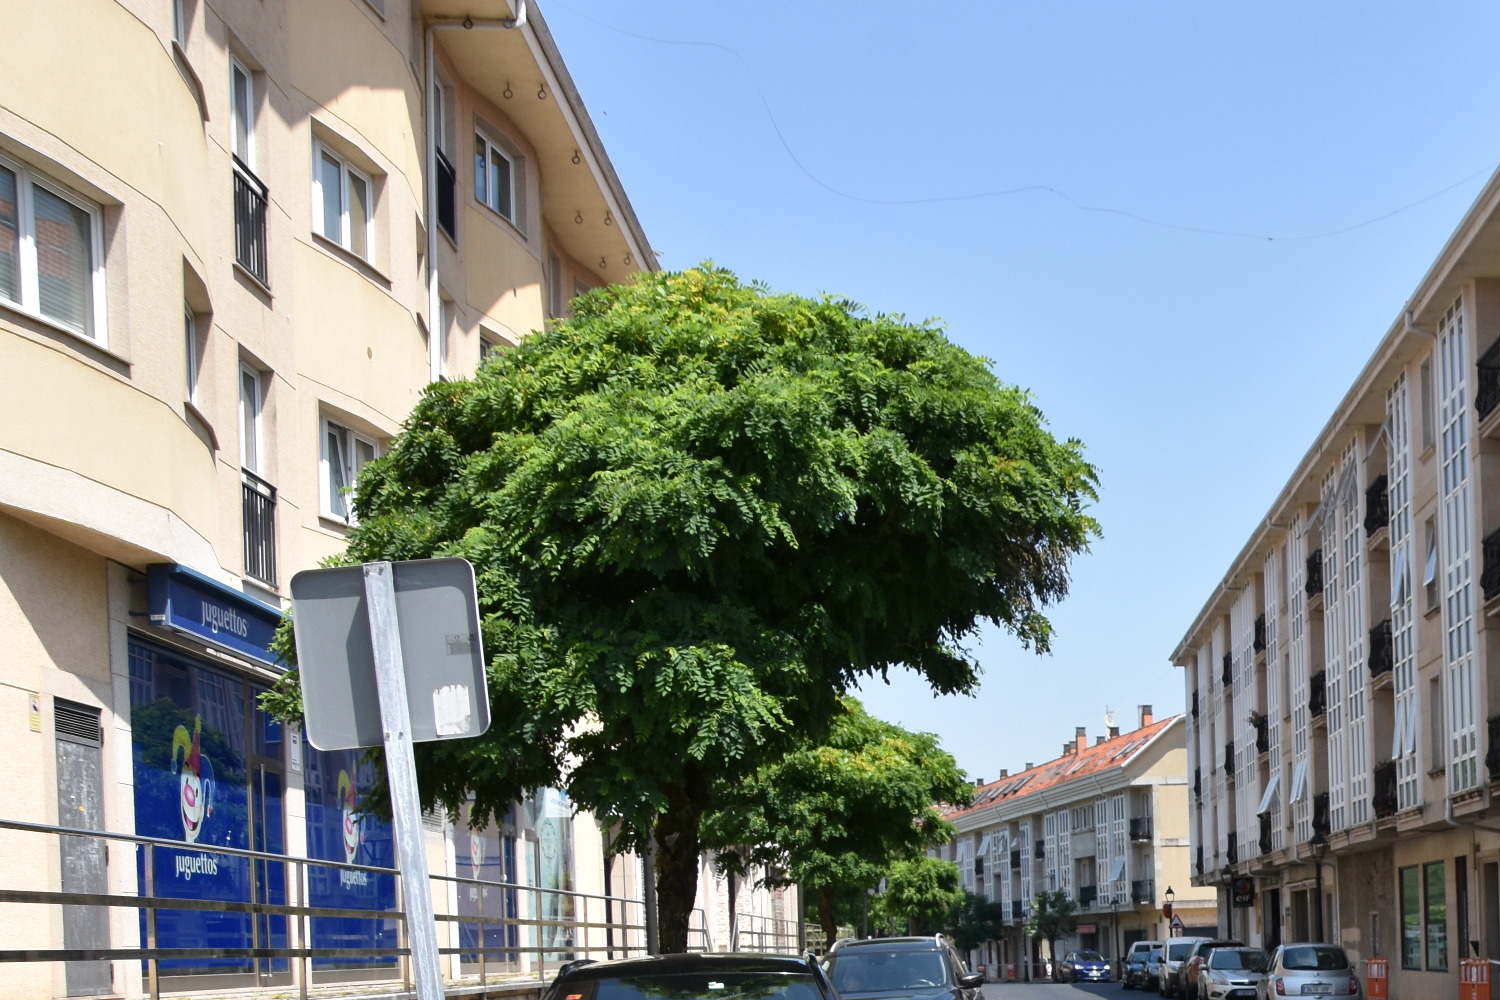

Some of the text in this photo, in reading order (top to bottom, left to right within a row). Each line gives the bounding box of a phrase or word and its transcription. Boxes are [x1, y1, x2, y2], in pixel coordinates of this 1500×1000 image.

[202, 601, 247, 637] juguettos
[175, 854, 218, 880] juguettos
[340, 868, 368, 889] juguettos
